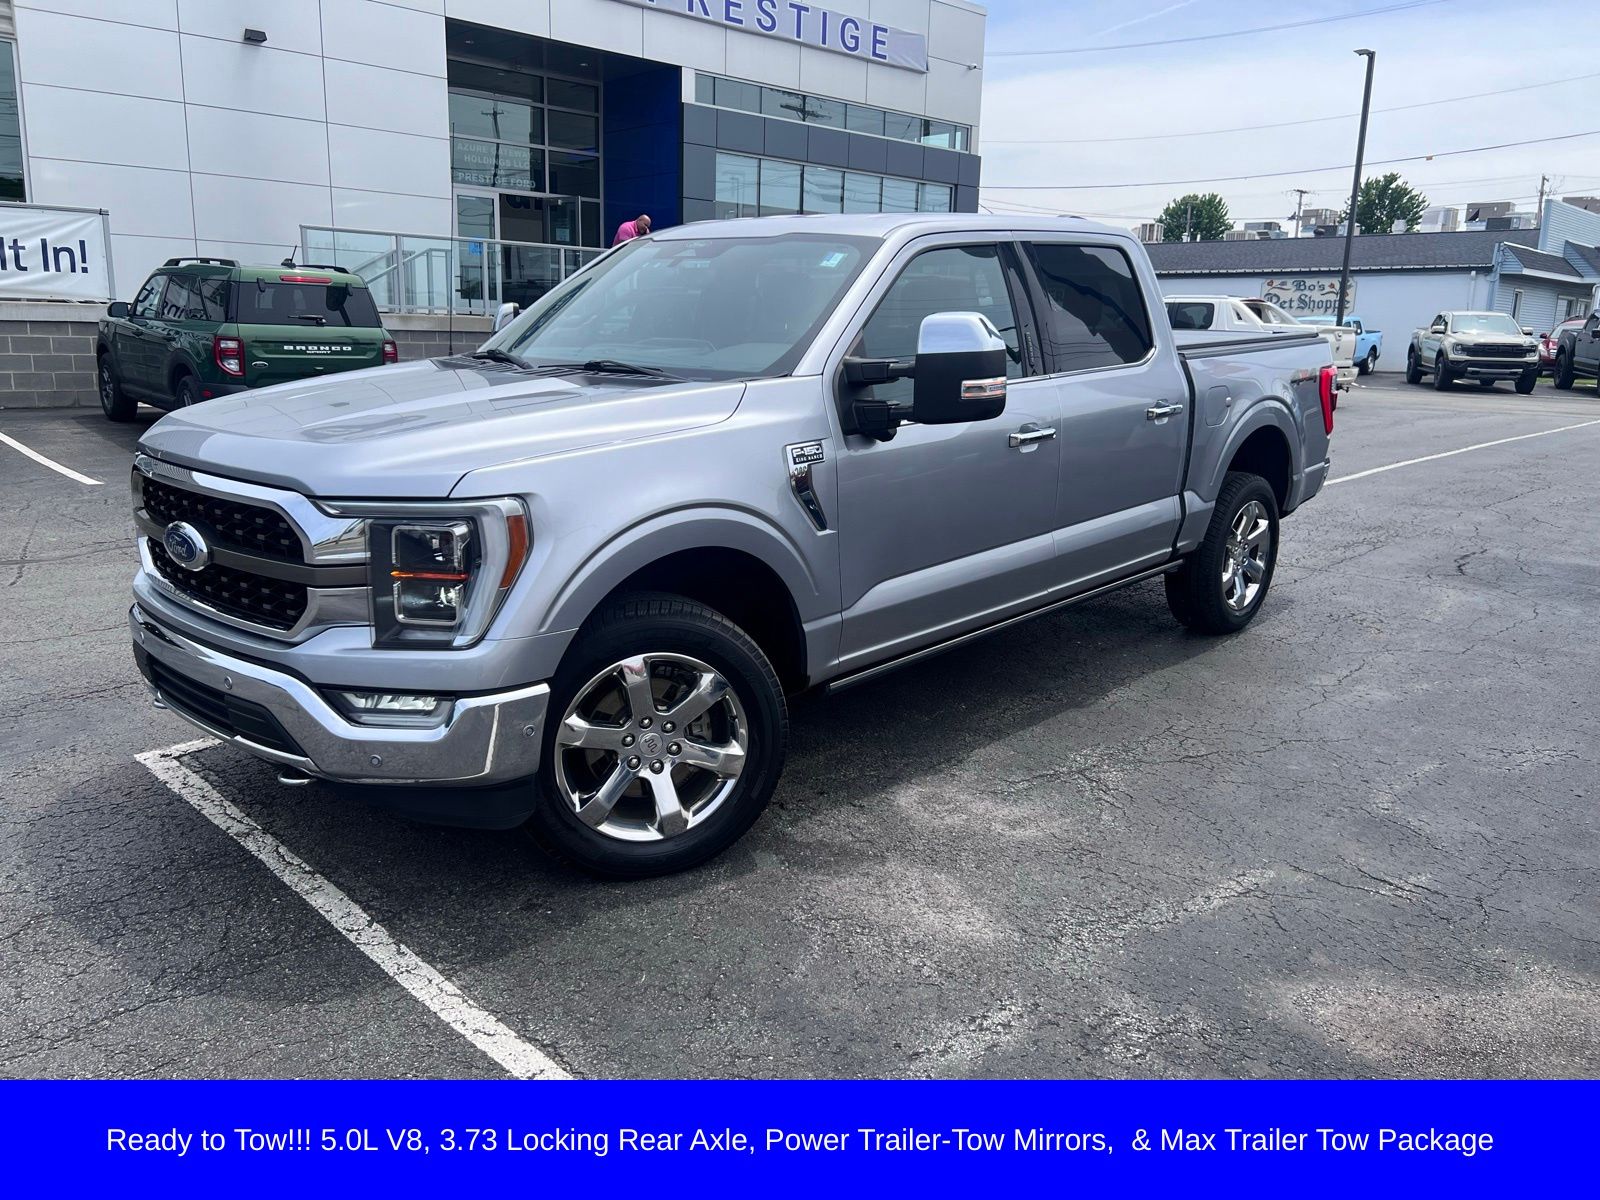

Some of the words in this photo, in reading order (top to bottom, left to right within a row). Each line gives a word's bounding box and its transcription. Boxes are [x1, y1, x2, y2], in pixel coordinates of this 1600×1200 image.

[648, 0, 889, 60] ESTIGE
[457, 143, 488, 154] AZURE
[464, 154, 511, 166] HOLDINGS
[458, 173, 509, 185] PRESTIGE
[510, 178, 536, 188] FORD
[40, 238, 88, 273] In!
[1292, 280, 1325, 291] Bo's
[1264, 293, 1293, 309] Pet
[792, 446, 823, 457] F-150
[168, 533, 188, 558] Ford
